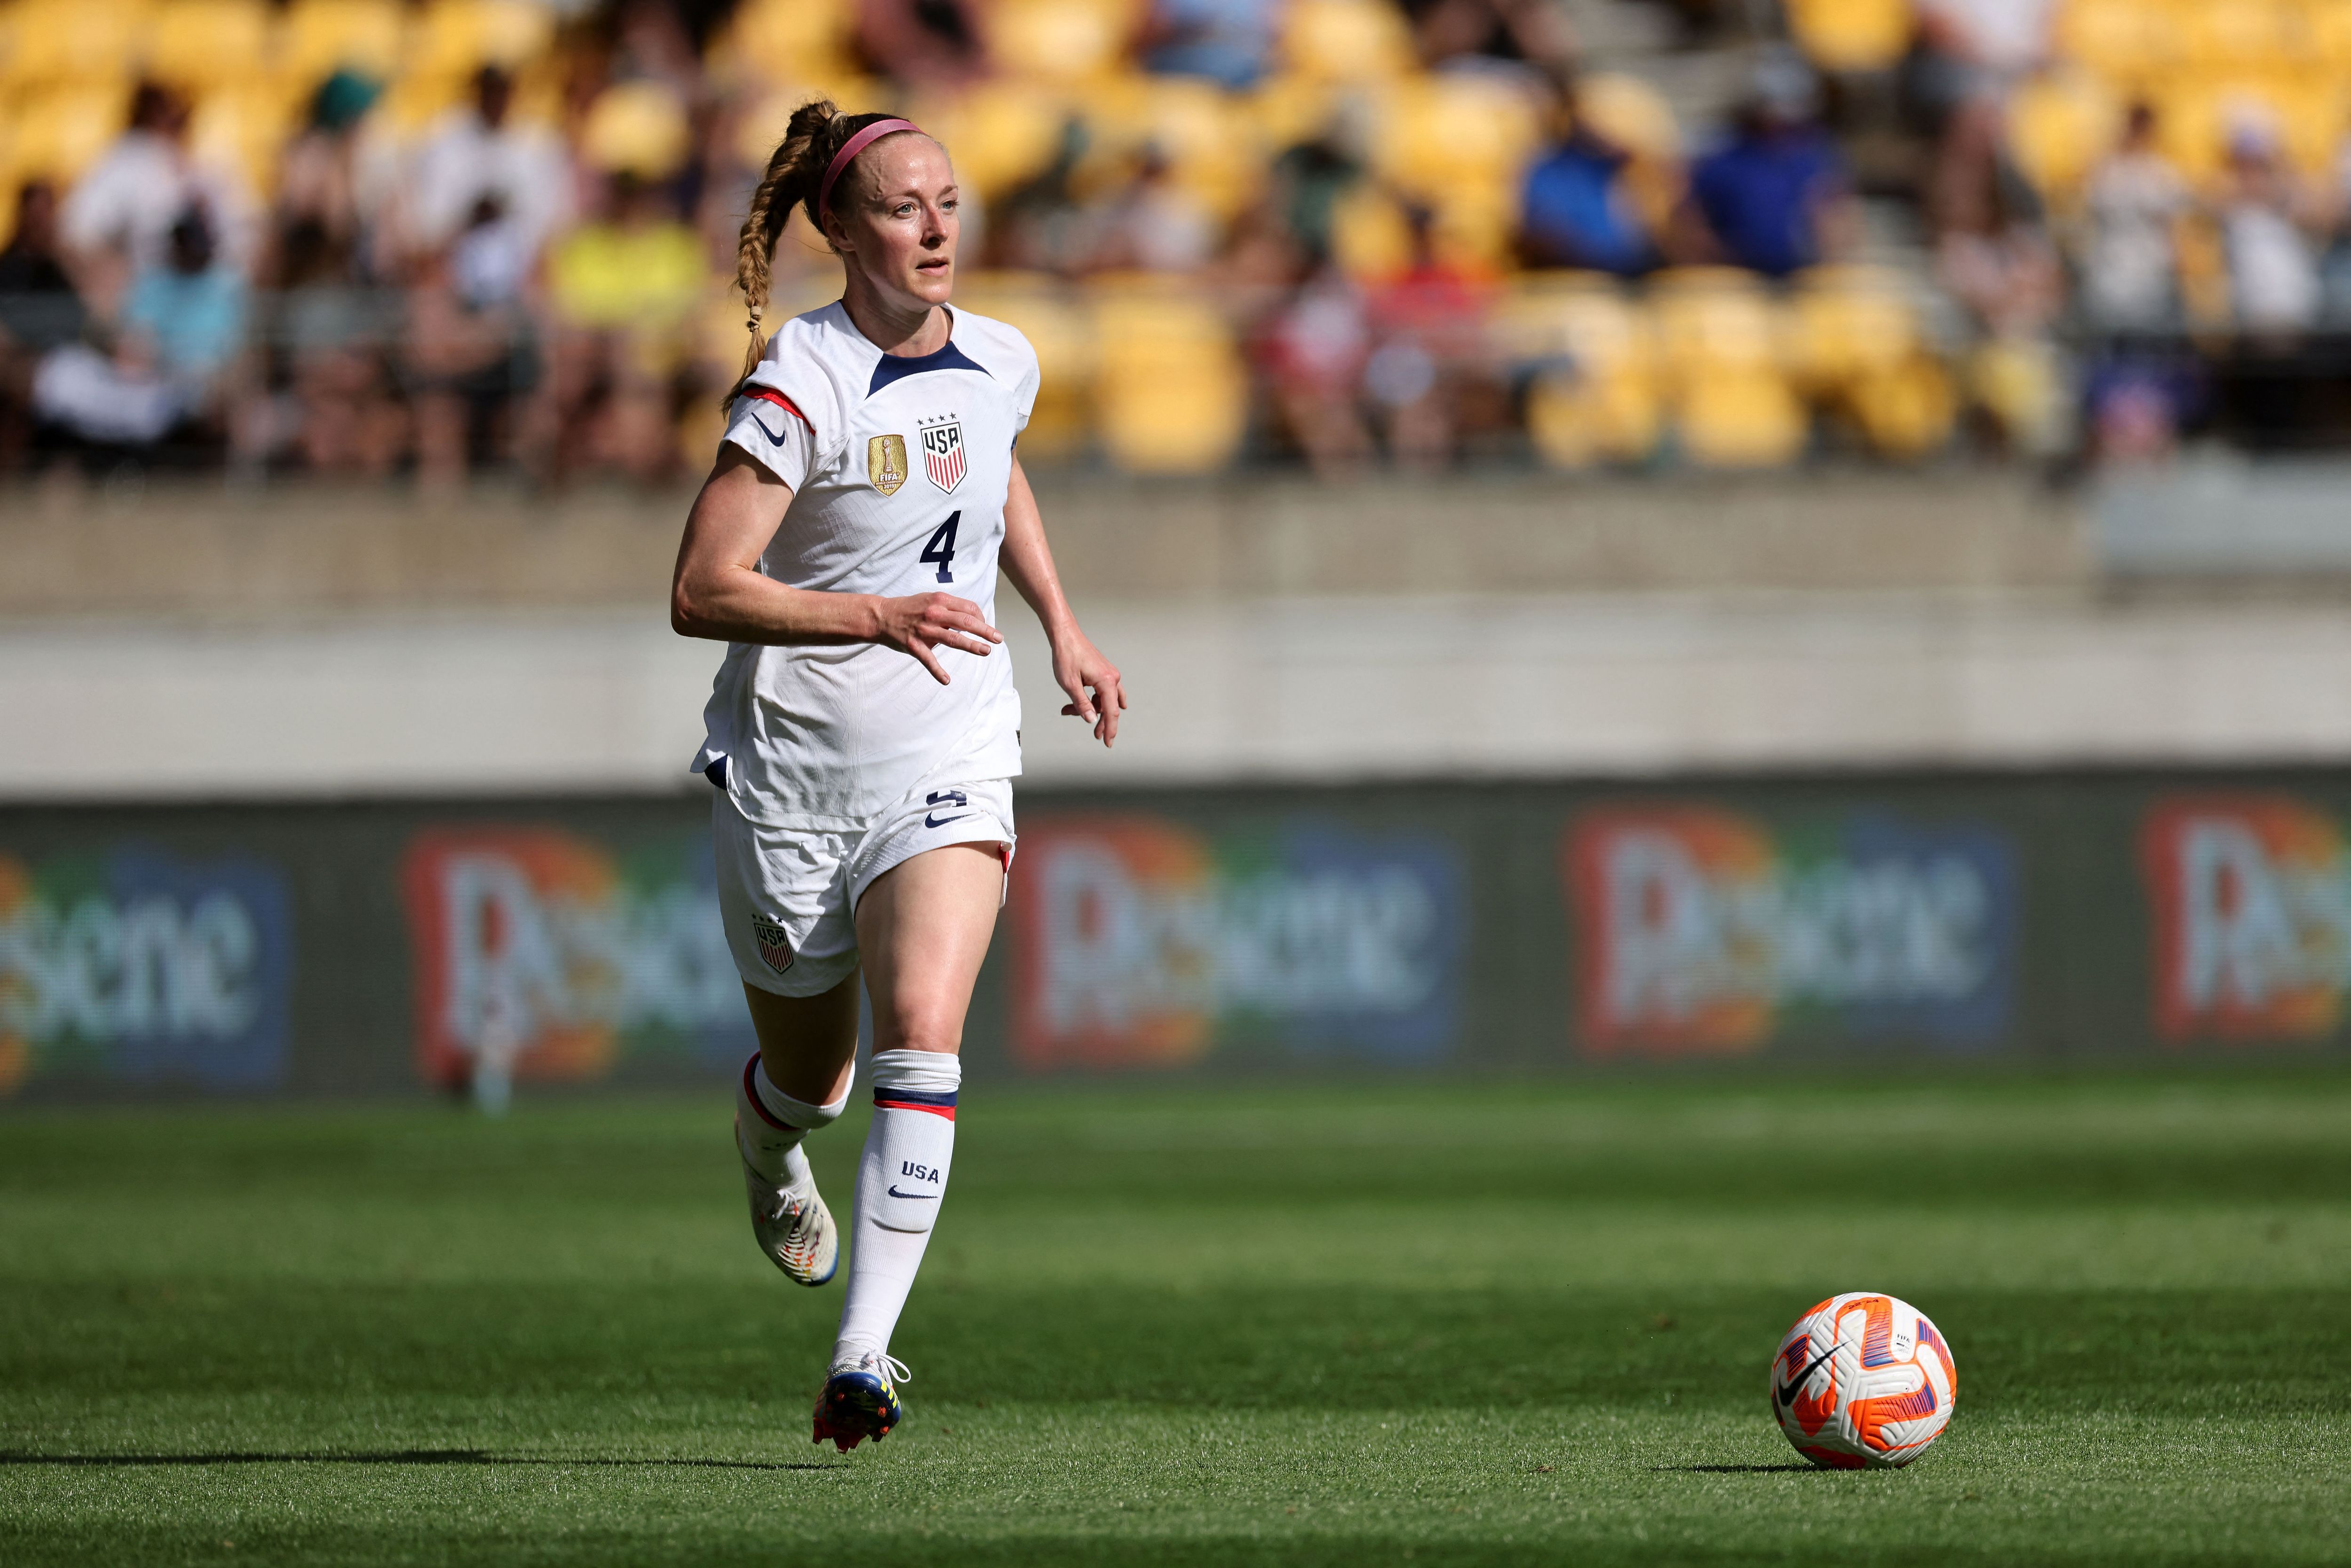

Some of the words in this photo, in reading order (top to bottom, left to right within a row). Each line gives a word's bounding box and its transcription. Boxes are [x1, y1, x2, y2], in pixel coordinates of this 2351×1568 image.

[924, 427, 959, 454] USA
[880, 473, 898, 482] FIFA
[919, 510, 961, 583] 4
[757, 926, 785, 946] USA
[902, 1161, 938, 1184] USA
[1897, 1334, 1910, 1343] FIFA
